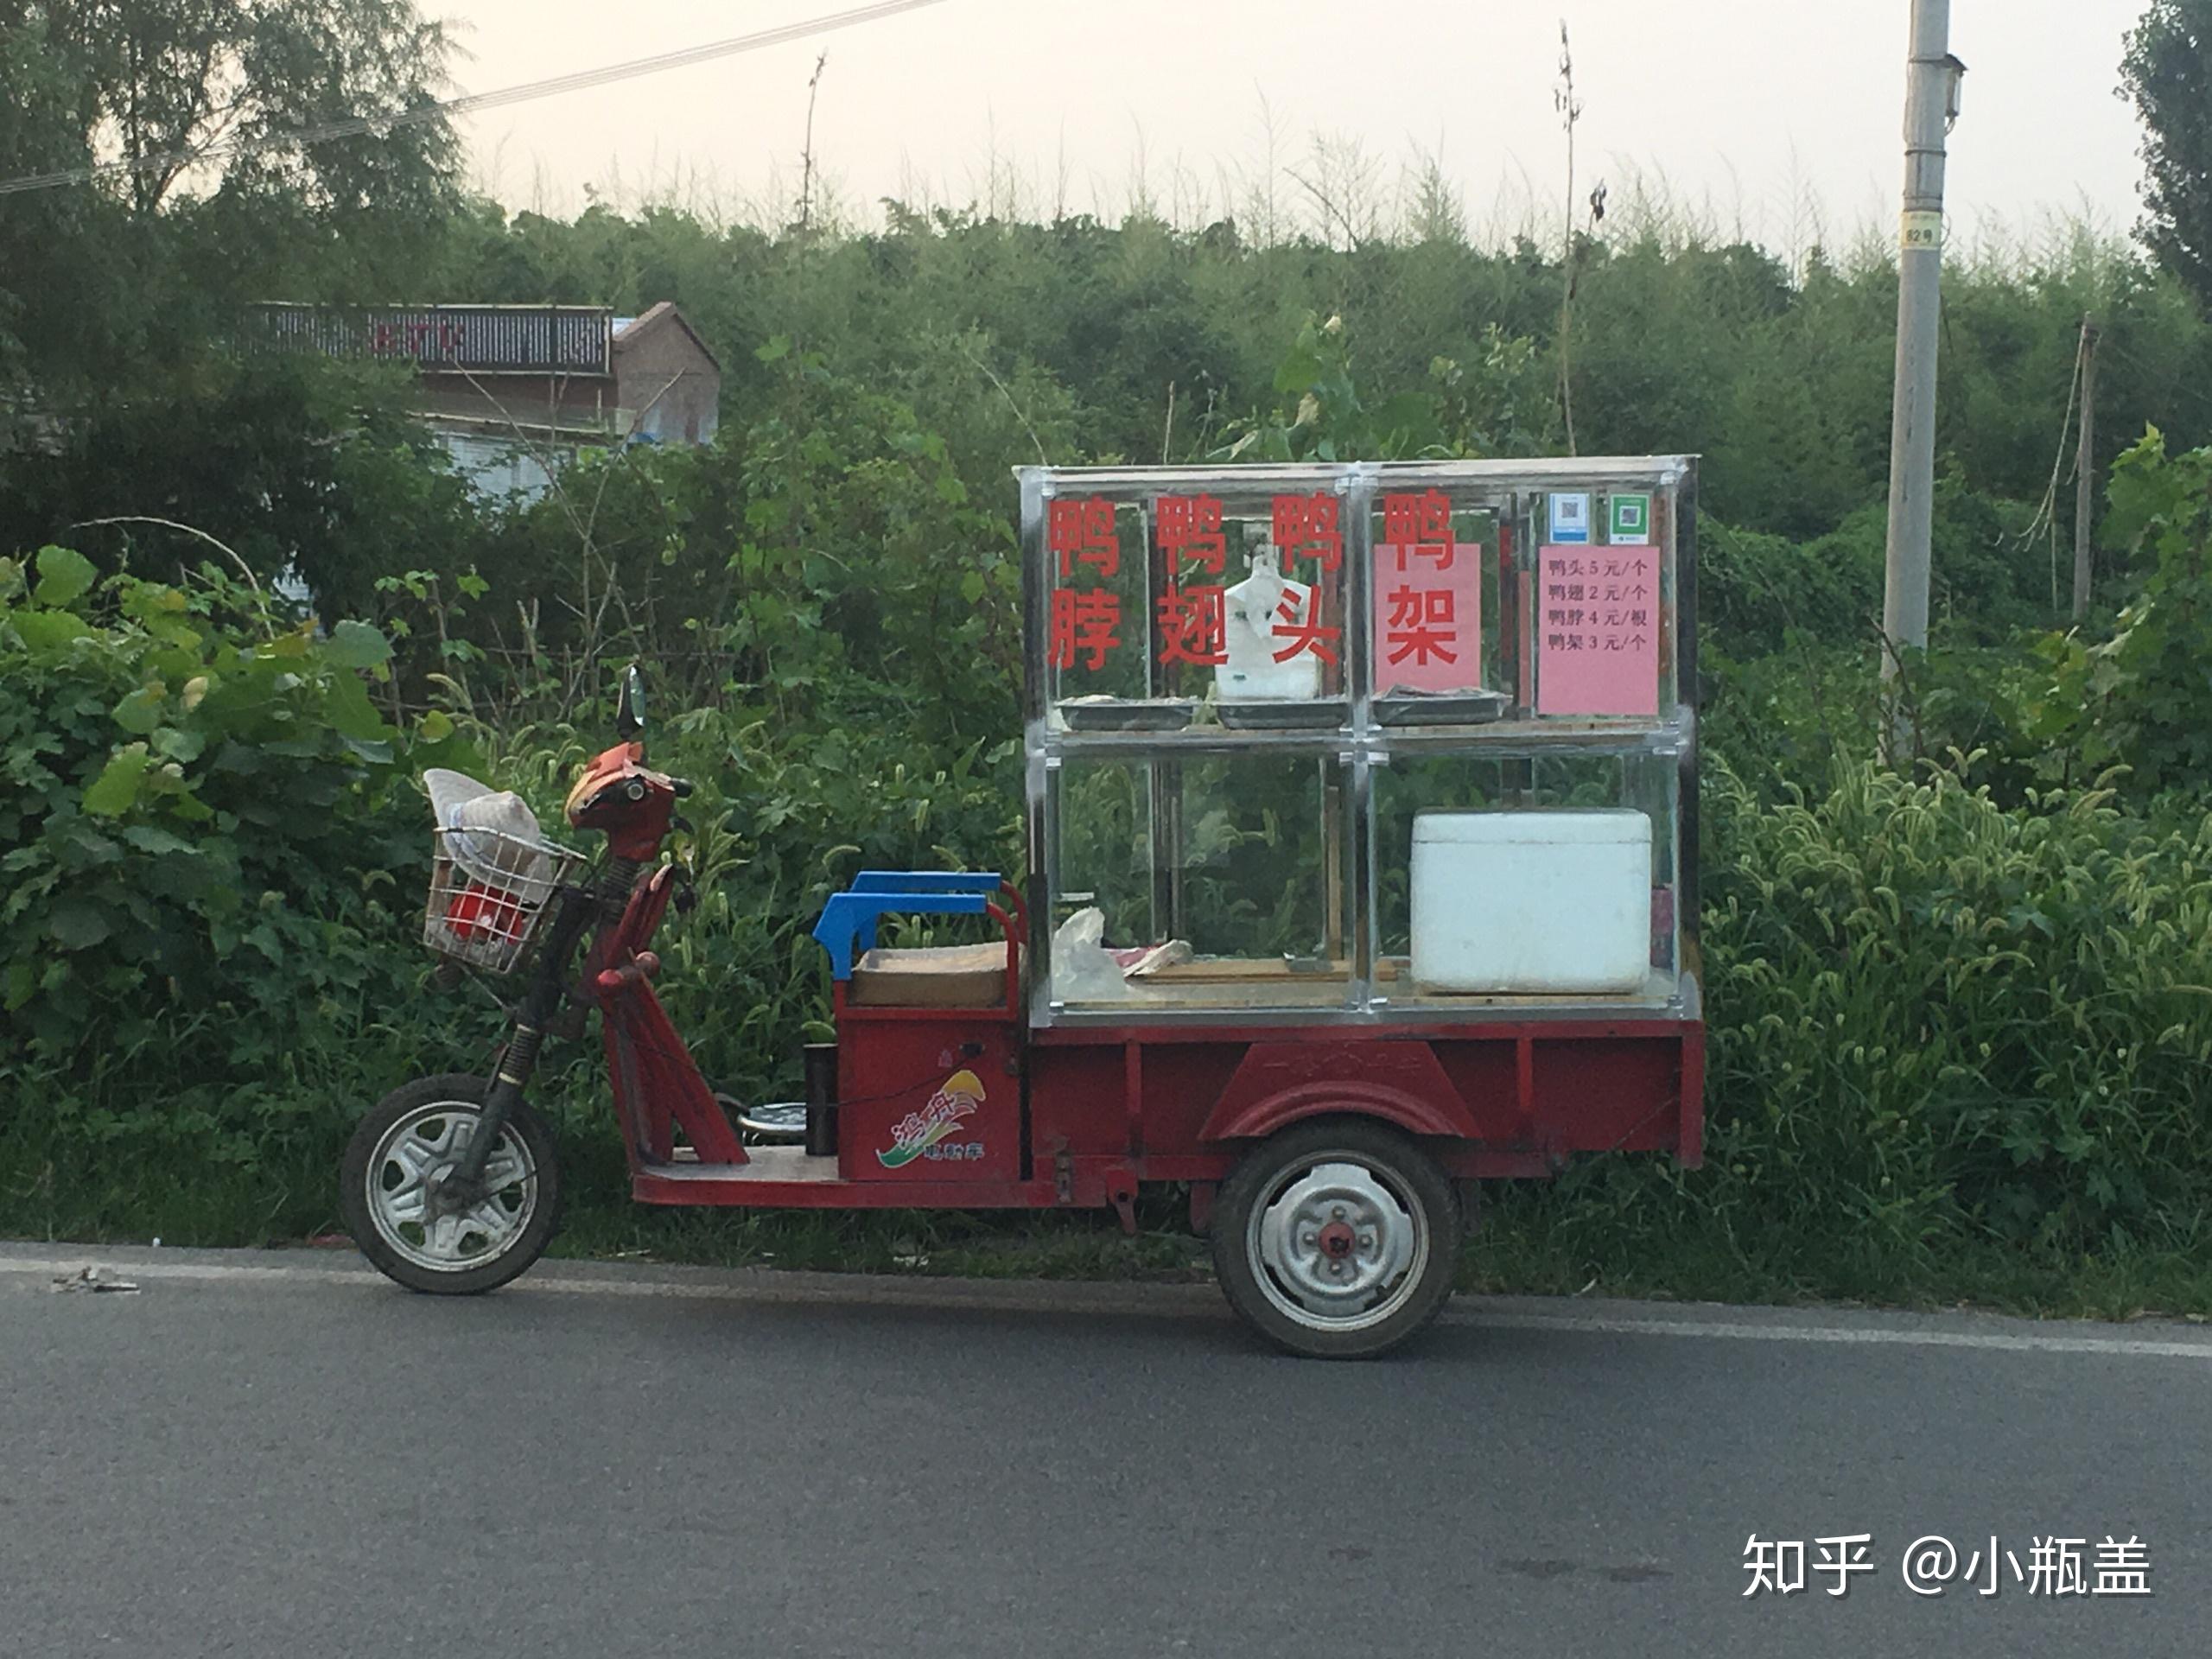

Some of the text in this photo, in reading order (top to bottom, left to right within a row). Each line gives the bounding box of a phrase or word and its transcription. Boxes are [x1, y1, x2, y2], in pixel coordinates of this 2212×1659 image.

[1048, 495, 1122, 671] 鸭脖
[1156, 493, 1229, 664] 鸭翅
[1271, 492, 1342, 665] 鸭头
[1384, 489, 1457, 666] 鸭架
